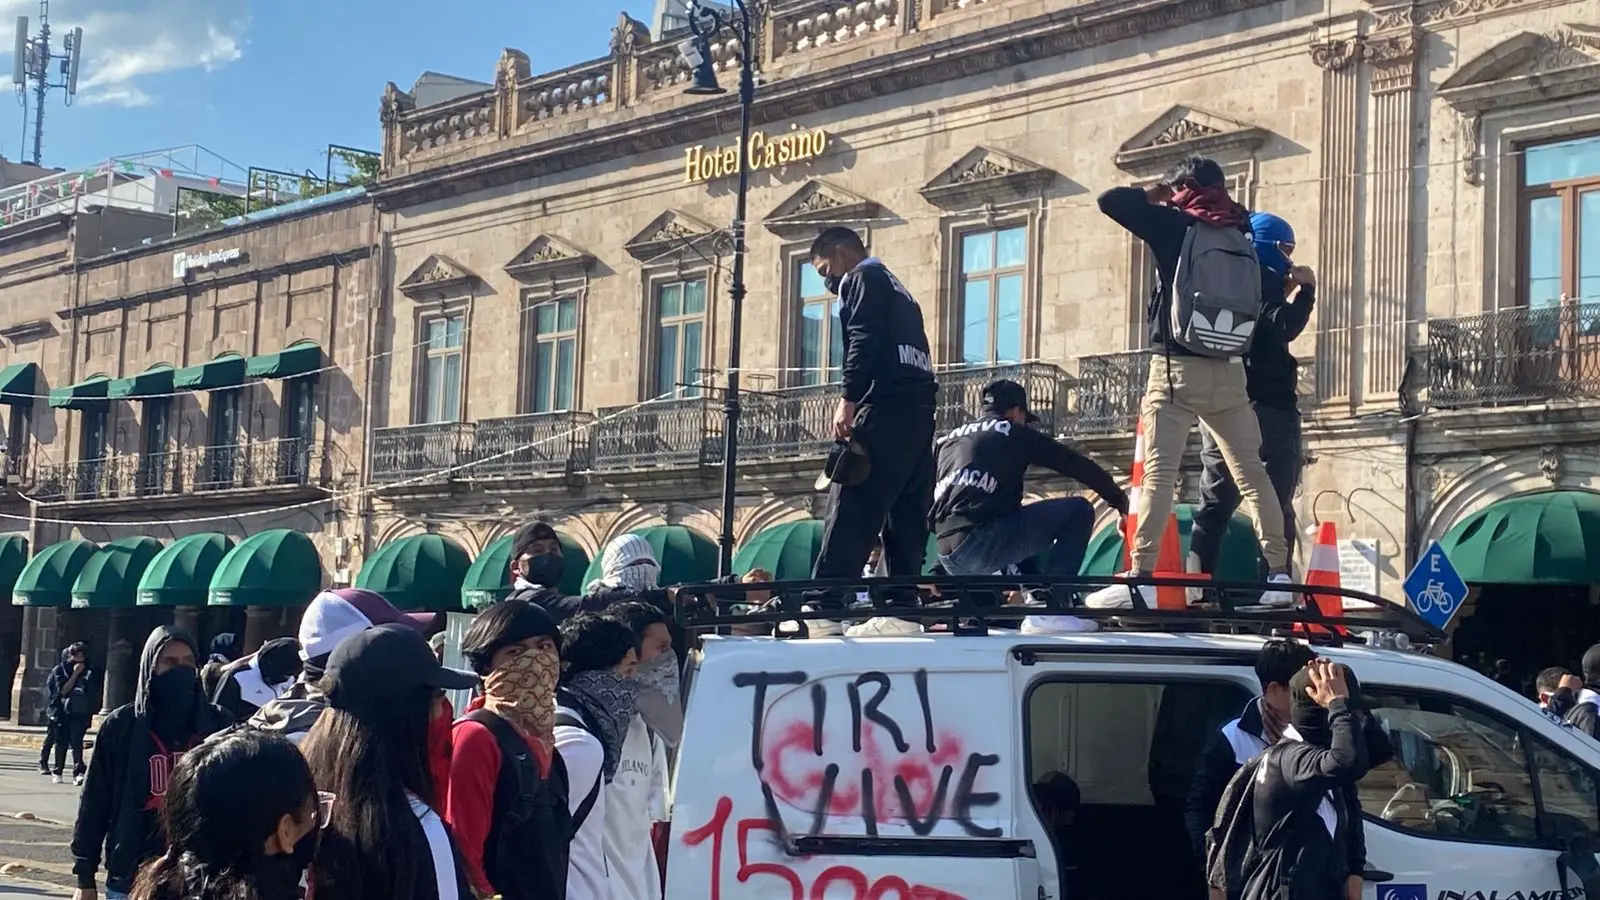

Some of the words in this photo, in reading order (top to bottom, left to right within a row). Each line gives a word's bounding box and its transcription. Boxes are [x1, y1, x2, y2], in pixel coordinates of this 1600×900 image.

[684, 136, 741, 182] Hotel
[748, 123, 826, 170] Casino
[1430, 553, 1441, 573] E
[732, 667, 938, 757] TIRI
[760, 752, 1003, 856] VIVE
